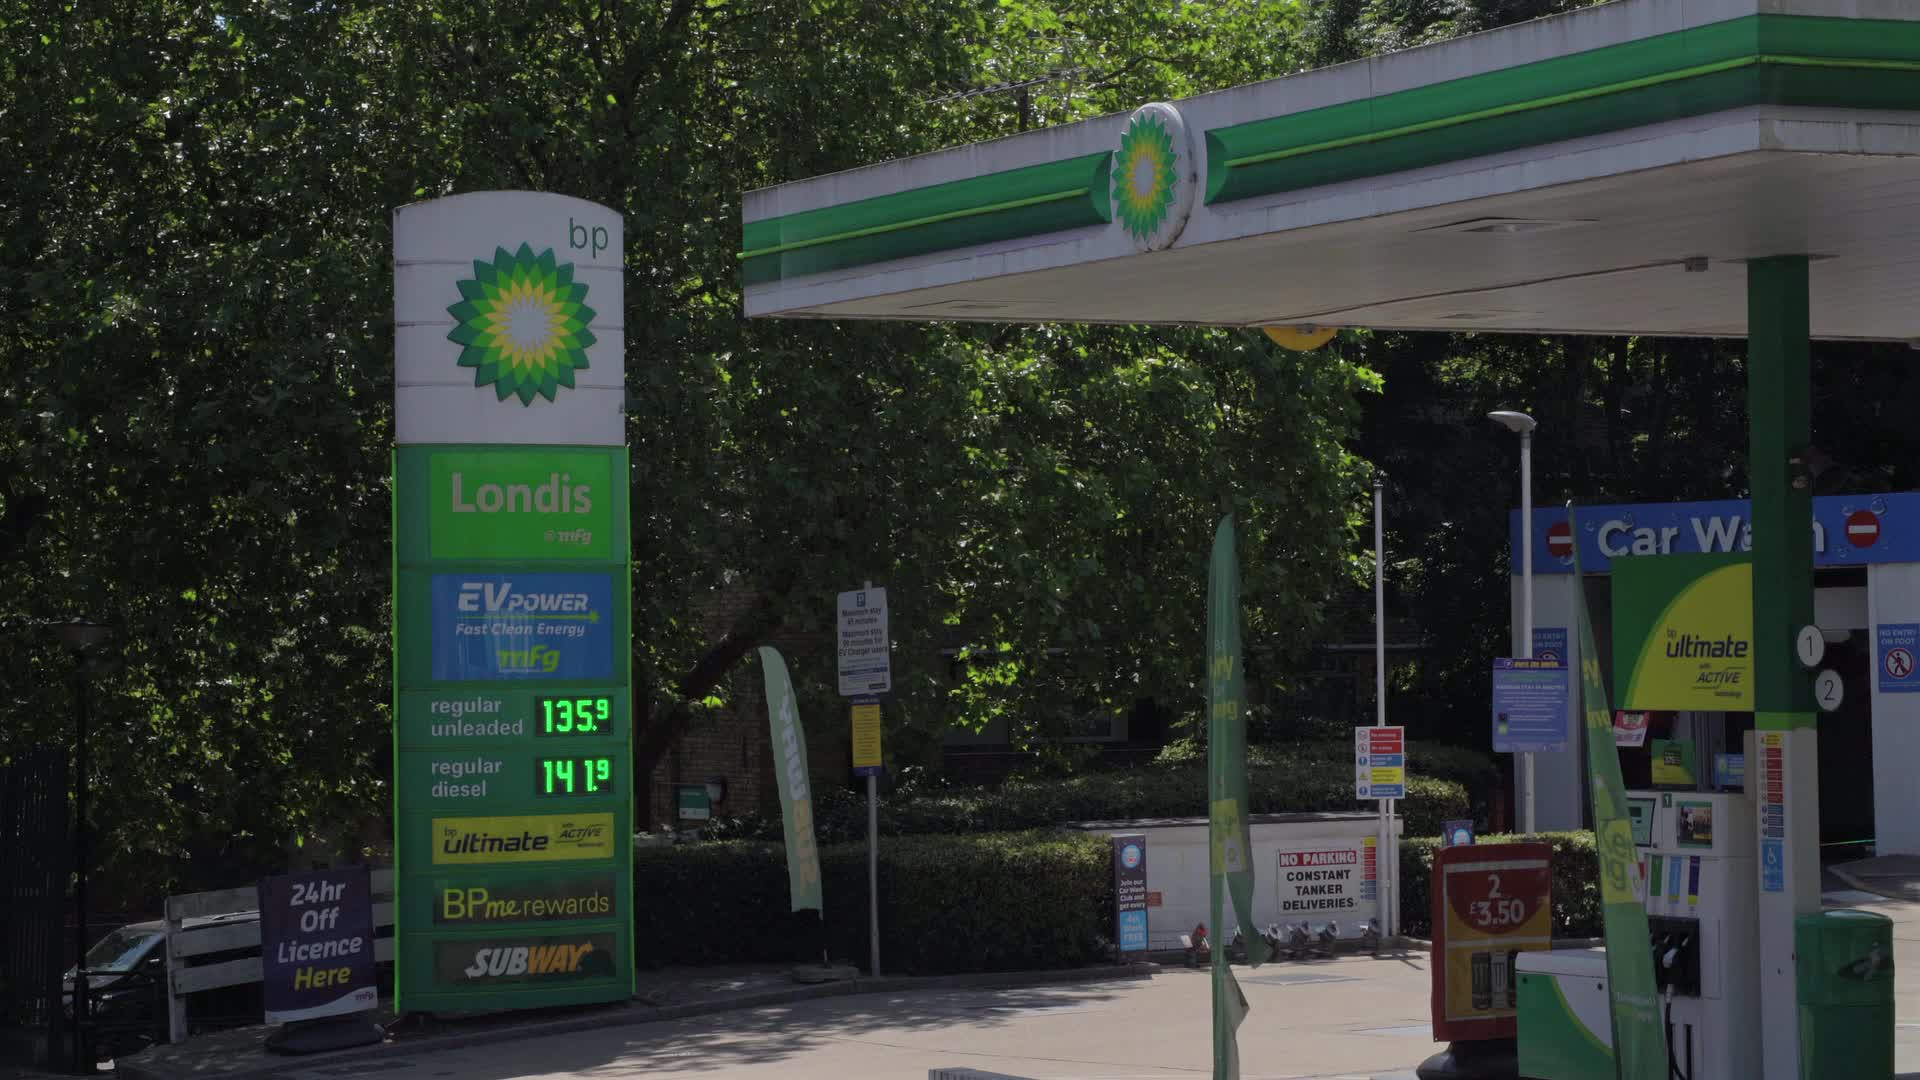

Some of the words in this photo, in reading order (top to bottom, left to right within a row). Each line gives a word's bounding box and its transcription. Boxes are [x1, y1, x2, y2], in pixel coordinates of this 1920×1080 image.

[570, 217, 608, 258] bp
[451, 472, 593, 514] Londis
[1597, 519, 1679, 558] Car
[456, 622, 489, 636] Fast
[491, 622, 533, 636] Clean
[536, 622, 585, 639] Energy
[1666, 634, 1748, 658] ultimate
[1806, 635, 1813, 657] 1
[499, 644, 561, 673] mfg
[1696, 671, 1741, 684] ACTIVE
[1824, 679, 1836, 700] 2
[431, 697, 502, 718] regular
[544, 698, 609, 733] 135.9
[431, 719, 524, 737] unleaded
[431, 757, 503, 779] regular
[431, 780, 487, 798] diesel
[443, 832, 549, 854] ultimate
[1280, 853, 1299, 867] NO
[1303, 851, 1356, 866] PARKING
[1287, 869, 1351, 882] CONSTANT
[1488, 874, 1502, 898] 2
[290, 880, 346, 906] 24hr
[1295, 884, 1343, 896] TANKER
[523, 892, 609, 916] rewards
[1283, 898, 1354, 911] DELIVERIES
[1470, 898, 1525, 927] £3.50
[301, 907, 339, 931] Off
[277, 936, 363, 964] Licence
[464, 942, 593, 978] SUBWAY
[294, 966, 352, 990] Here
